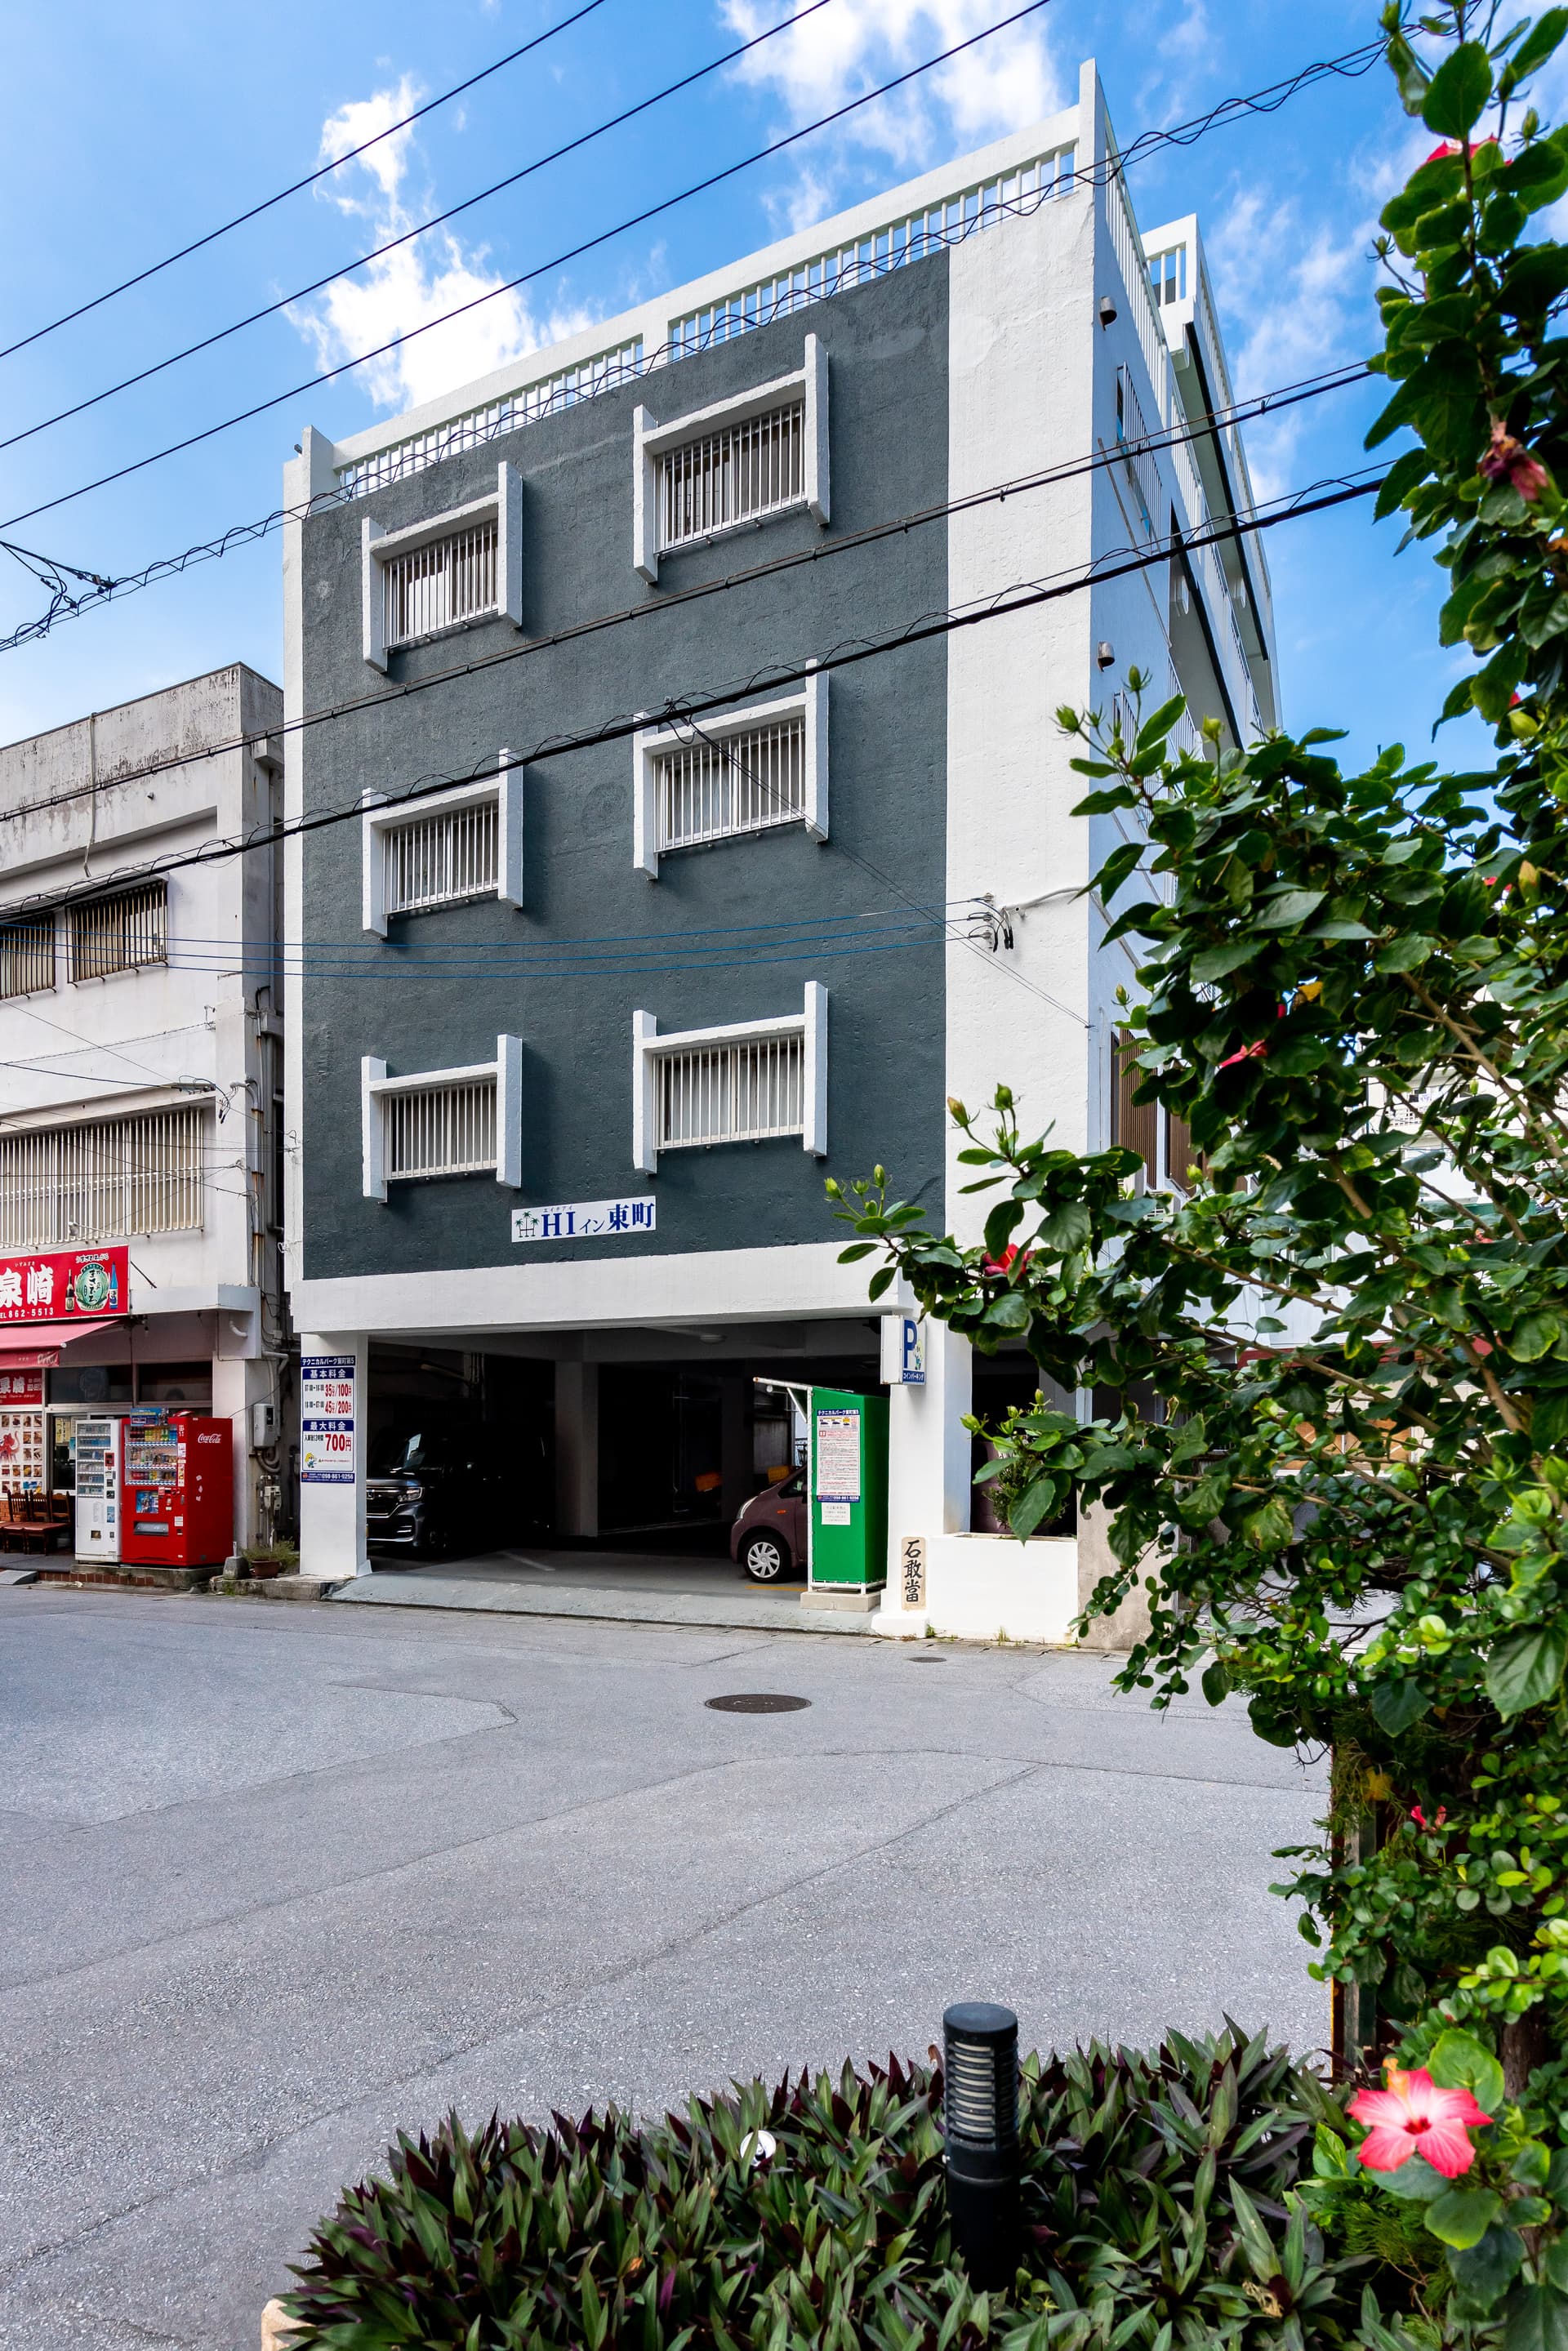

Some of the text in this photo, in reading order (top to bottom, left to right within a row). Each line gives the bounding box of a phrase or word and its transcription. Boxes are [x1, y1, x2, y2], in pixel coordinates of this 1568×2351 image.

[8, 1307, 54, 1318] 862-5513
[904, 1319, 917, 1369] P
[310, 1369, 346, 1378] 基本料金
[903, 1373, 924, 1381] コインパーキング
[310, 1421, 346, 1431] 最大料金
[325, 1433, 352, 1452] 700円
[903, 1539, 923, 1602] 石敢當
